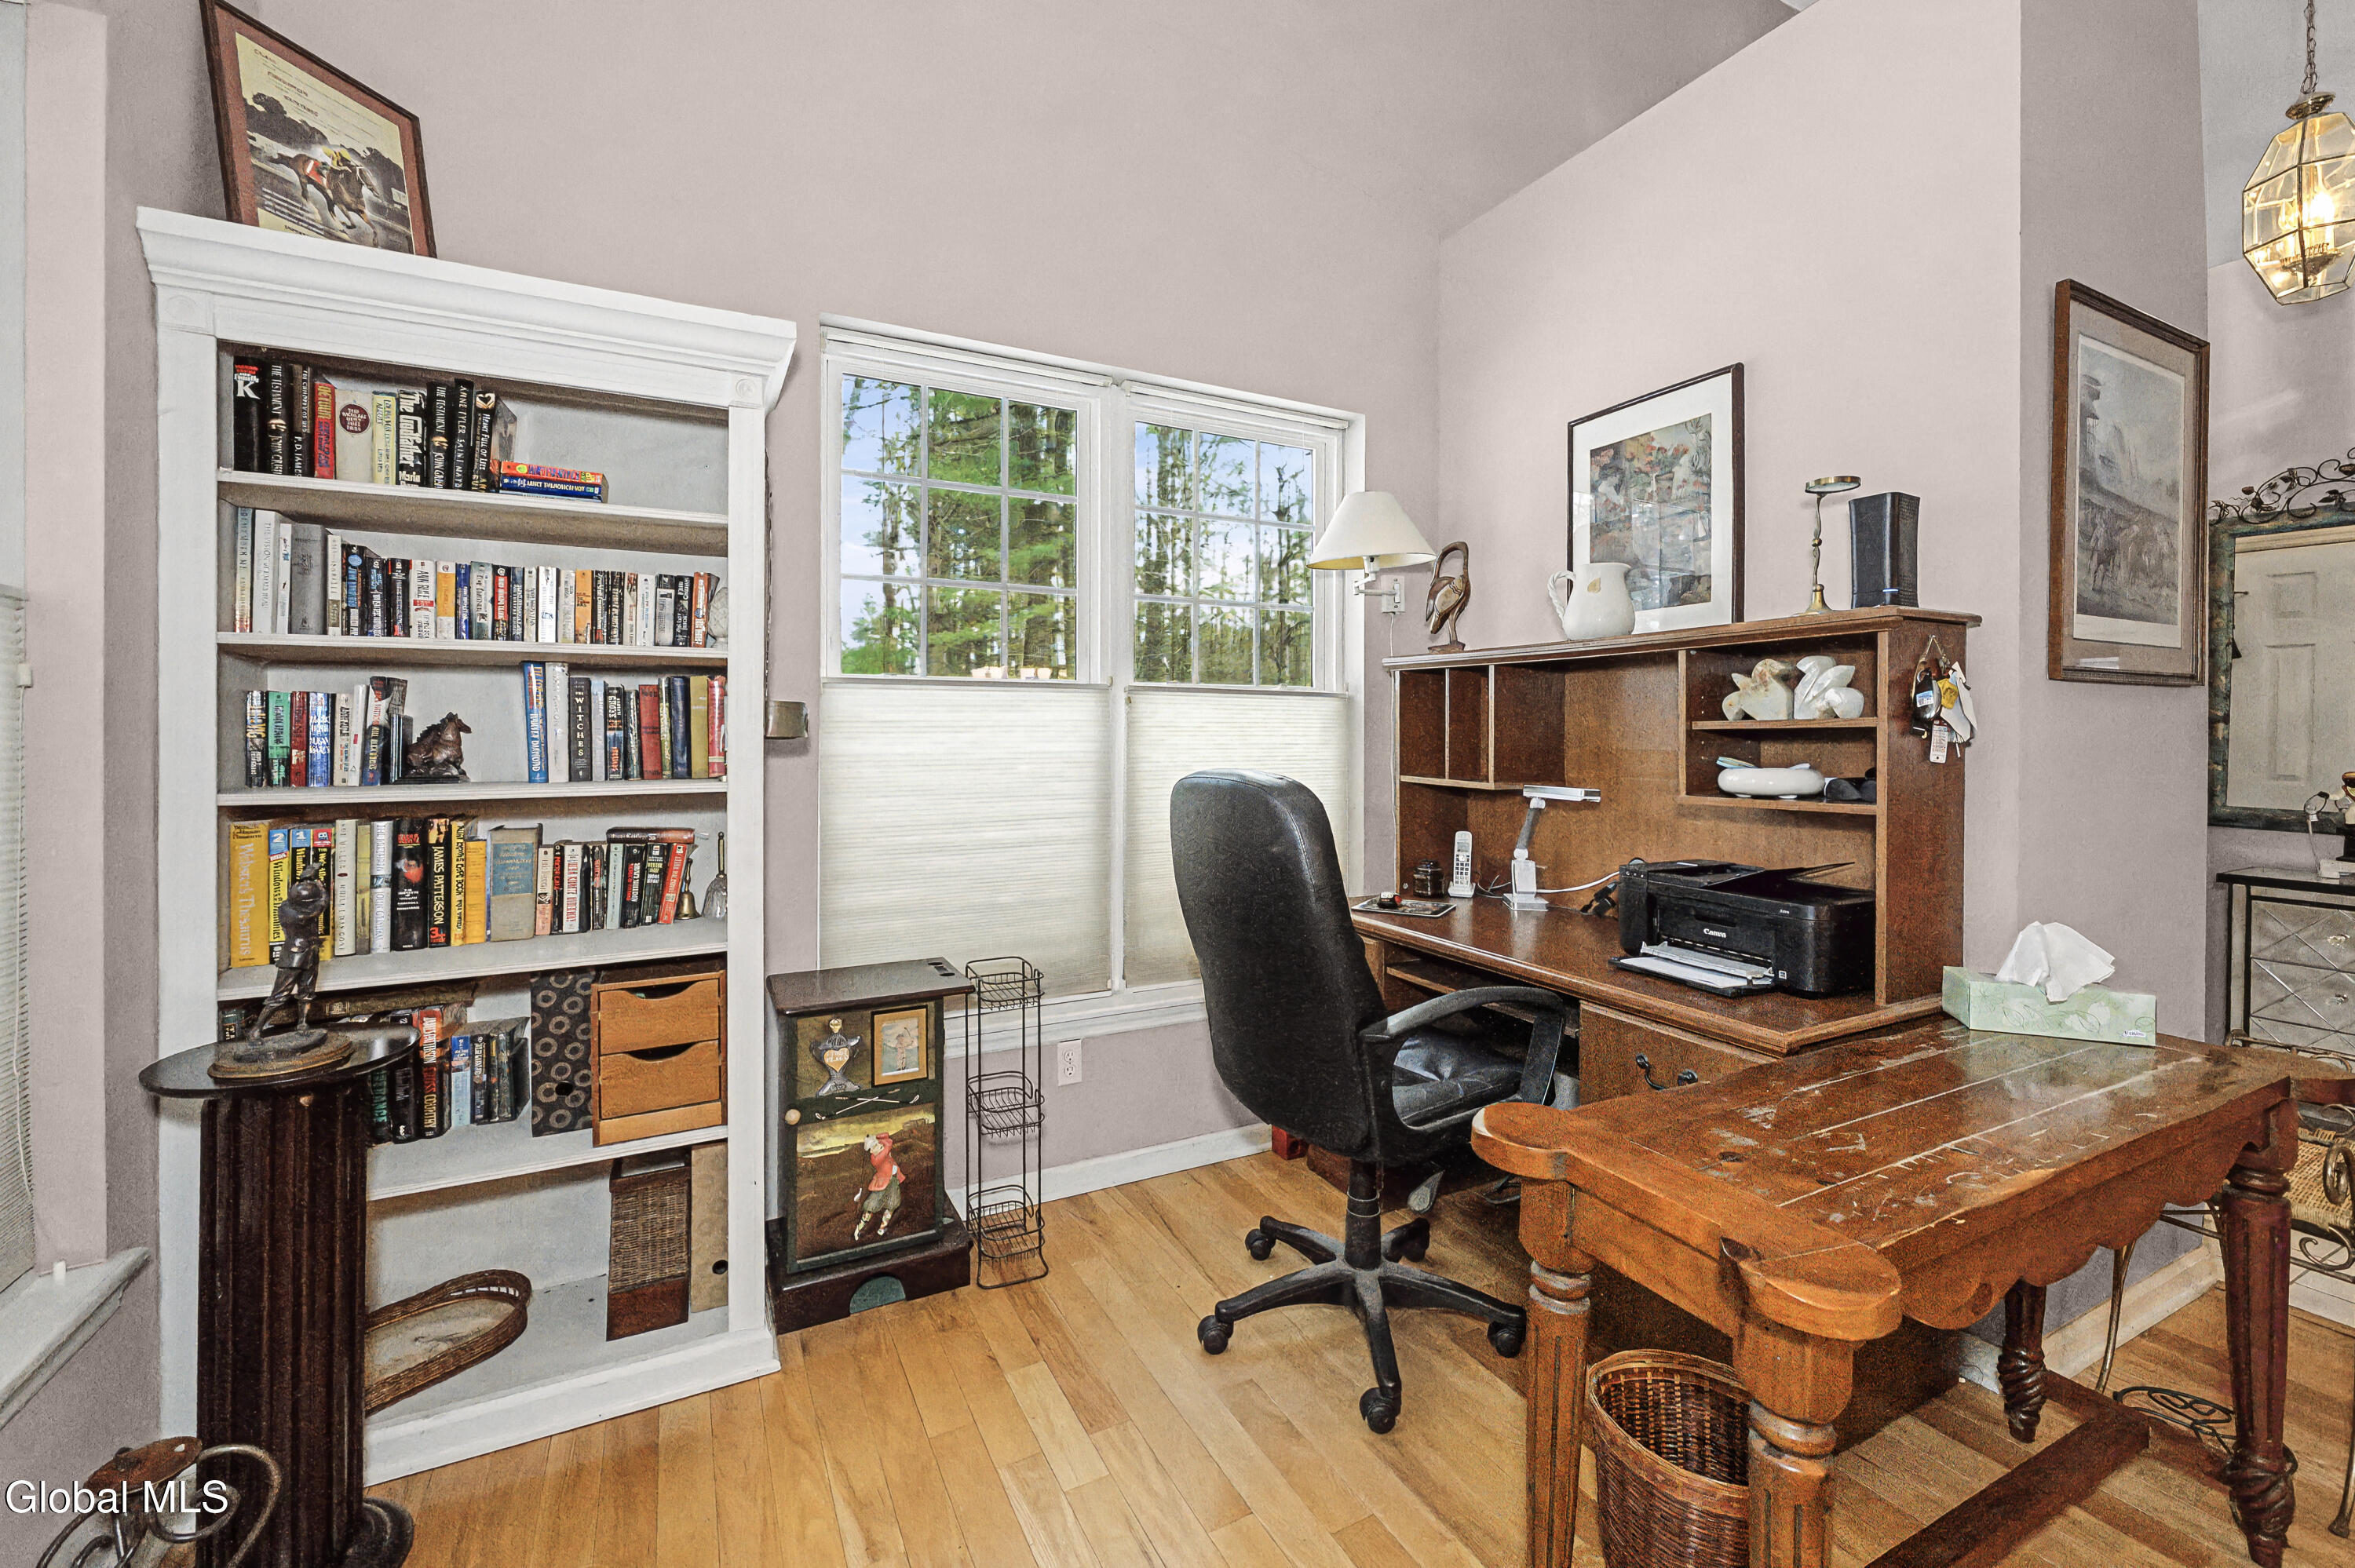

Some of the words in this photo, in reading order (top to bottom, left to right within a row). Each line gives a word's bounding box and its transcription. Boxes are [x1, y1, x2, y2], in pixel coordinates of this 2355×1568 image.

[575, 697, 584, 757] WITCHES
[433, 846, 444, 873] JAMES
[273, 861, 283, 896] Windows
[433, 874, 445, 924] PATTERSON
[1703, 928, 1727, 939] Canon
